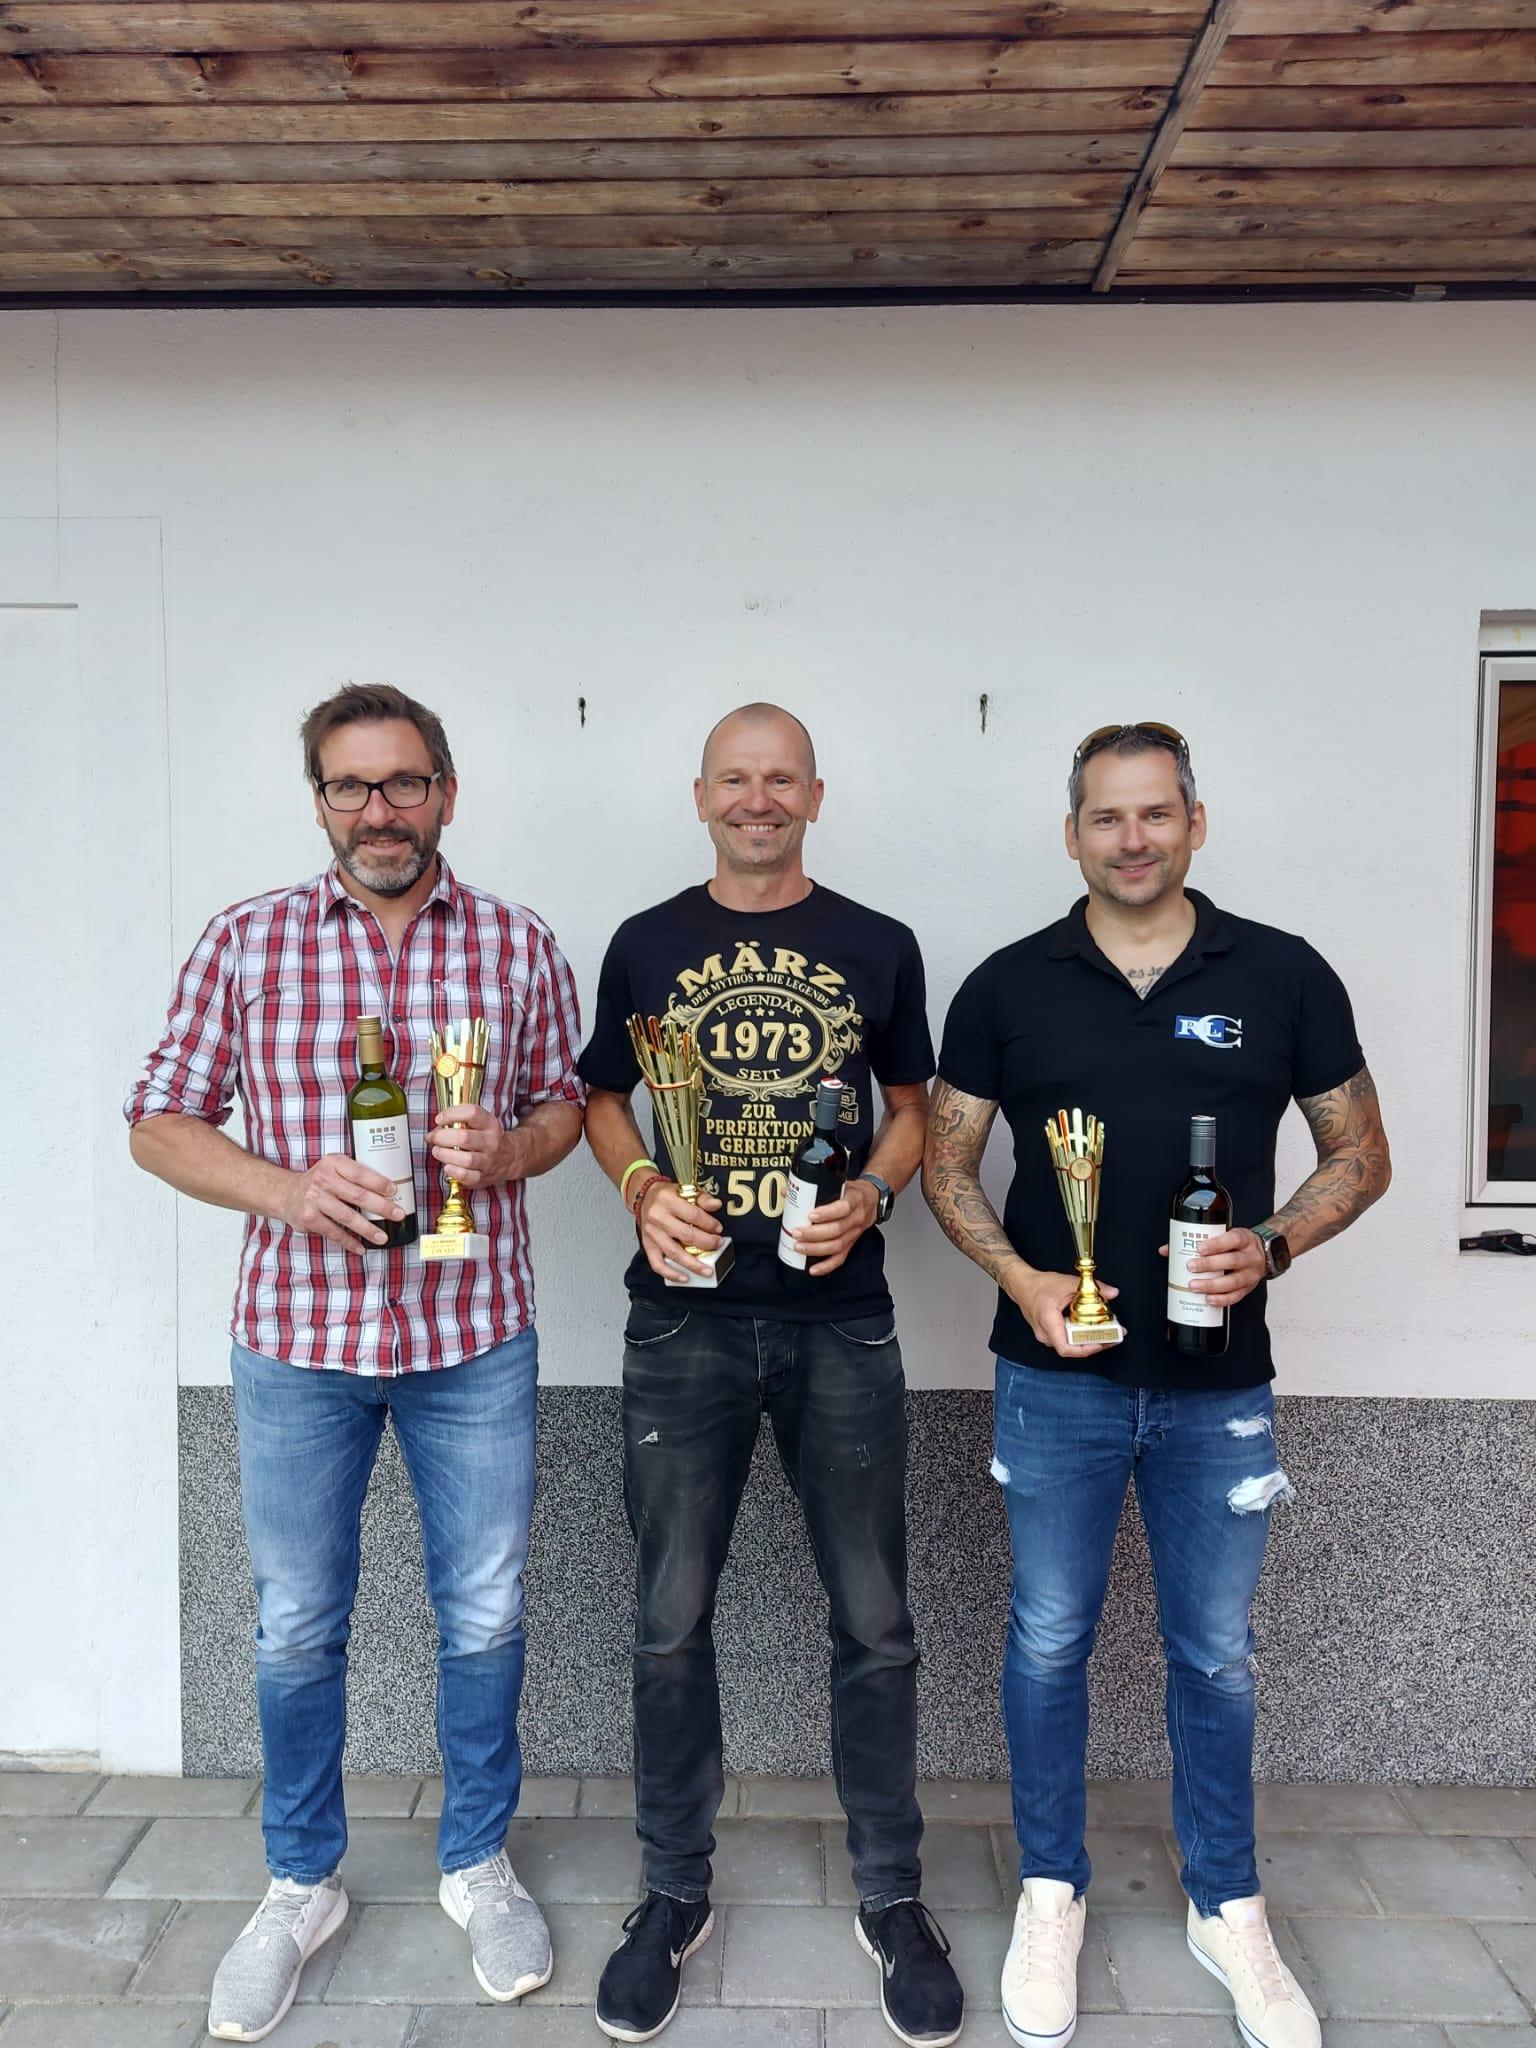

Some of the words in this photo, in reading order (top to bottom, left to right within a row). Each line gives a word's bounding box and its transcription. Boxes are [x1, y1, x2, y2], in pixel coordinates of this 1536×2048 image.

[676, 941, 847, 997] MÄRZ
[691, 987, 711, 1006] DER
[711, 972, 754, 993] MYTHOS
[766, 973, 784, 985] DIE
[785, 977, 832, 1008] LEGENDE
[715, 994, 804, 1018] LEGENDÄR
[708, 1021, 812, 1062] 1973
[736, 1067, 781, 1081] SEIT
[741, 1103, 777, 1119] ZUR
[705, 1118, 815, 1138] PERFEKTION
[719, 1137, 799, 1155] GEREIFT
[704, 1151, 748, 1168] LEBEN
[751, 1155, 792, 1168] BEGIN
[726, 1169, 789, 1219] 50
